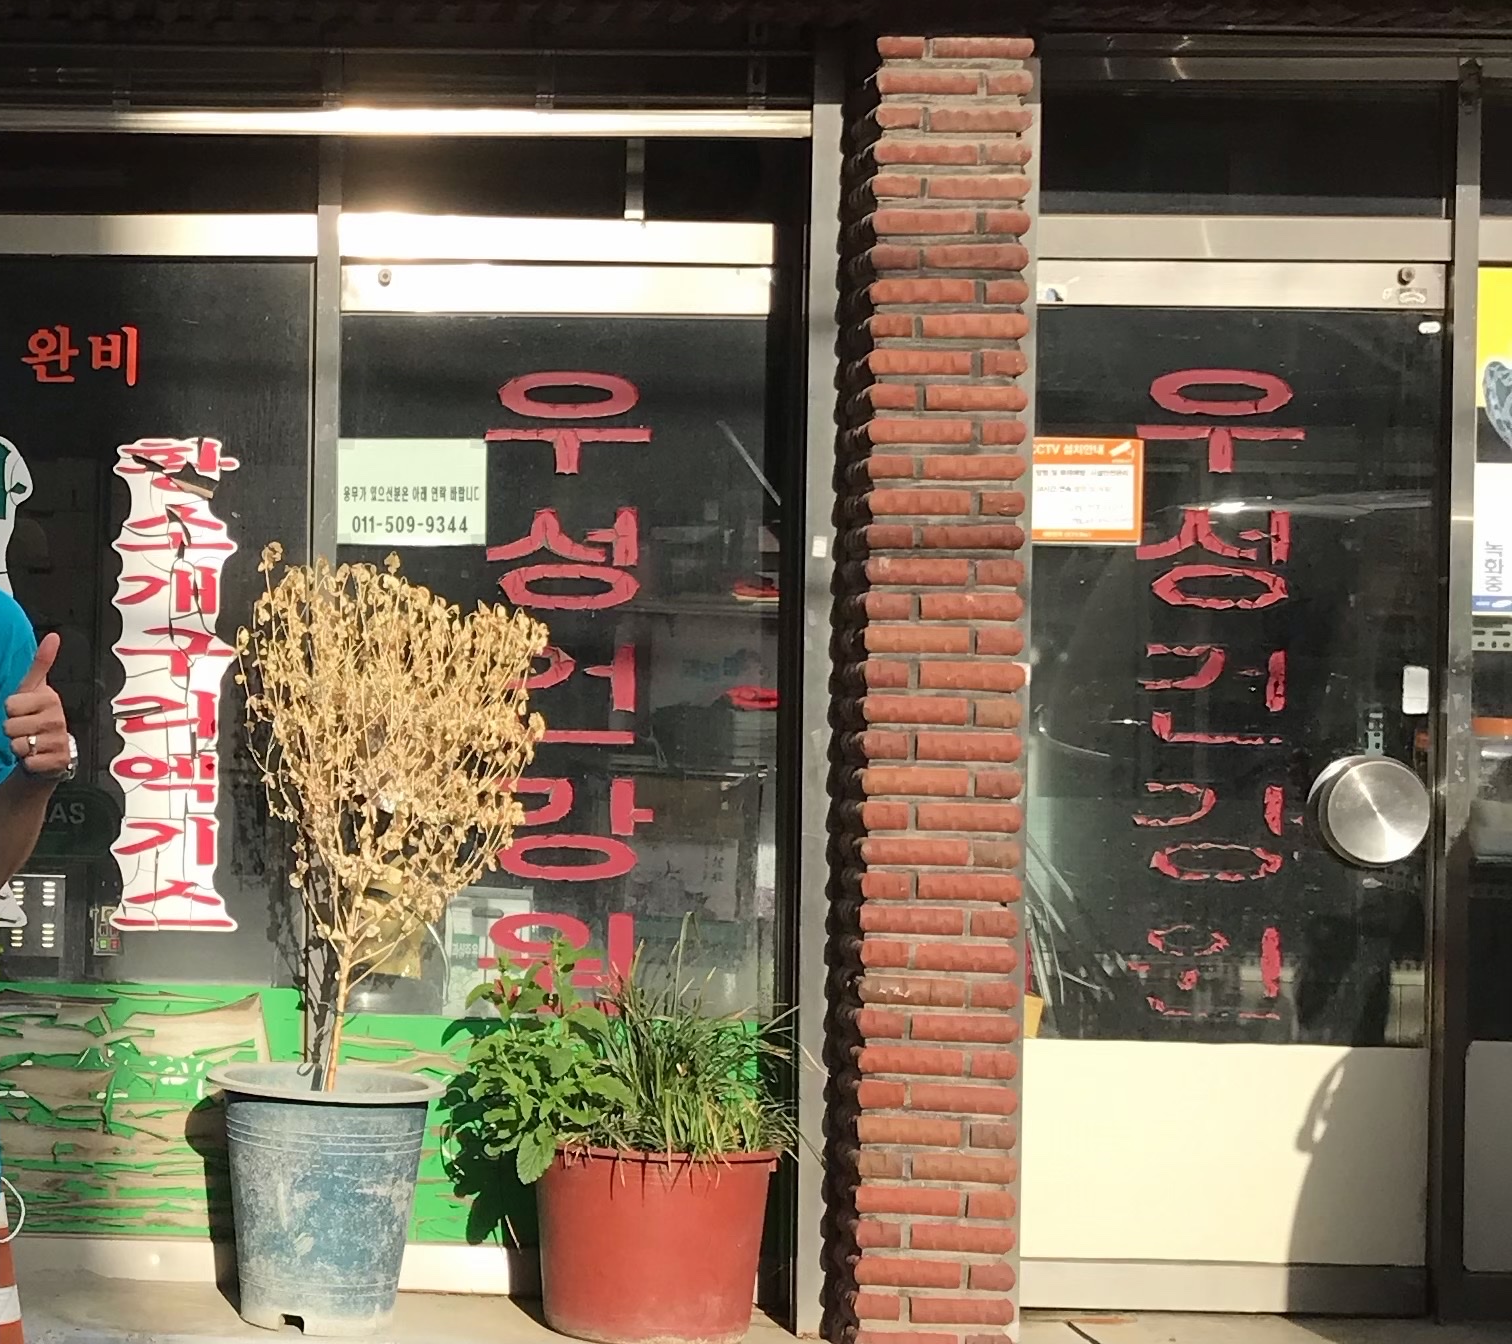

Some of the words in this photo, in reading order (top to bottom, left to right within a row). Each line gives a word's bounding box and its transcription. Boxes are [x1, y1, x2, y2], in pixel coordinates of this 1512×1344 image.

[21, 324, 138, 386] 완비
[343, 486, 367, 503] 용무가
[412, 486, 428, 502] 아래
[431, 486, 447, 503] 연락
[352, 515, 469, 534] 011-509-9344
